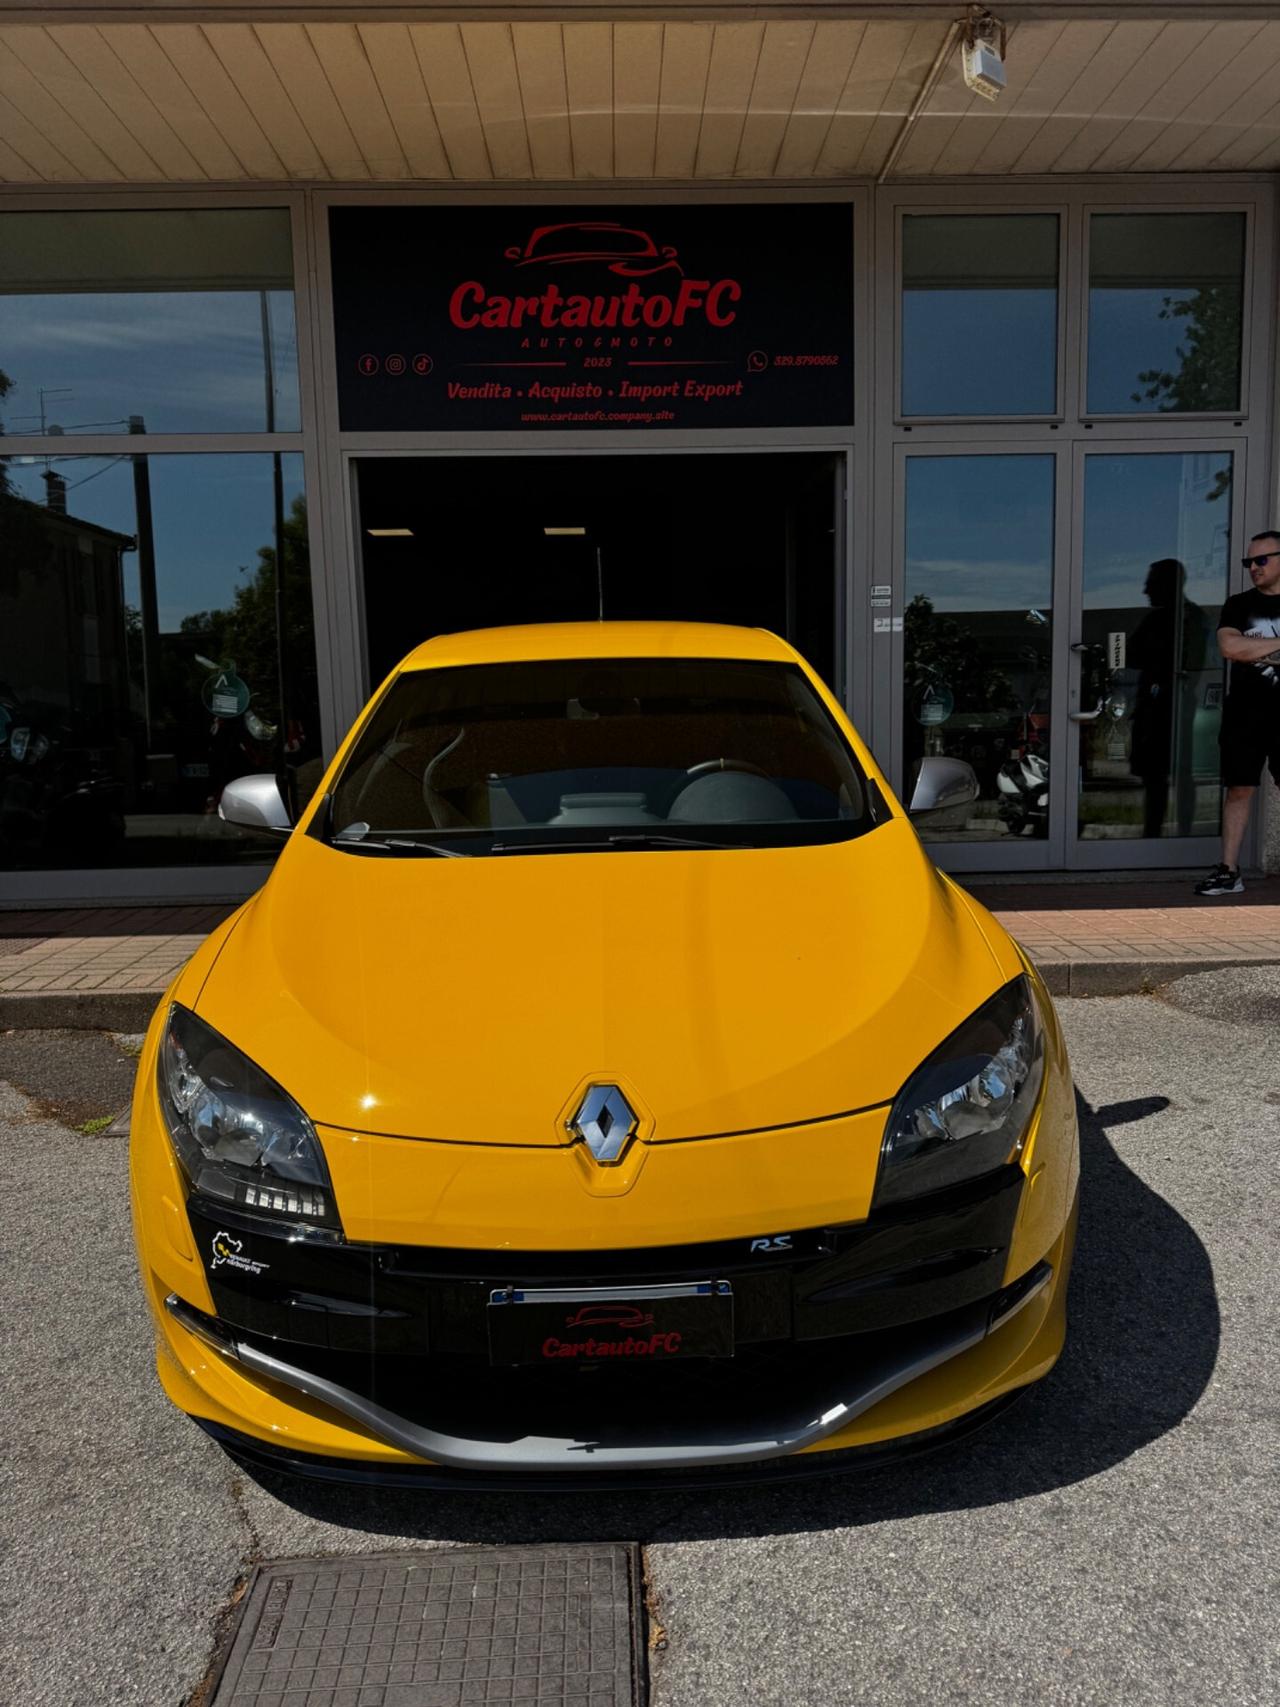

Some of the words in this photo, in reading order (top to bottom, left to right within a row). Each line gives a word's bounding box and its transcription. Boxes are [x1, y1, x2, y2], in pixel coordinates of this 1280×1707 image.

[449, 279, 742, 330] CartautoFC
[447, 382, 512, 400] Vendita
[527, 381, 603, 404] Acquisto
[618, 380, 681, 402] Import
[683, 379, 744, 402] Export
[750, 1235, 793, 1253] RS
[541, 1331, 682, 1358] CartautoFC
